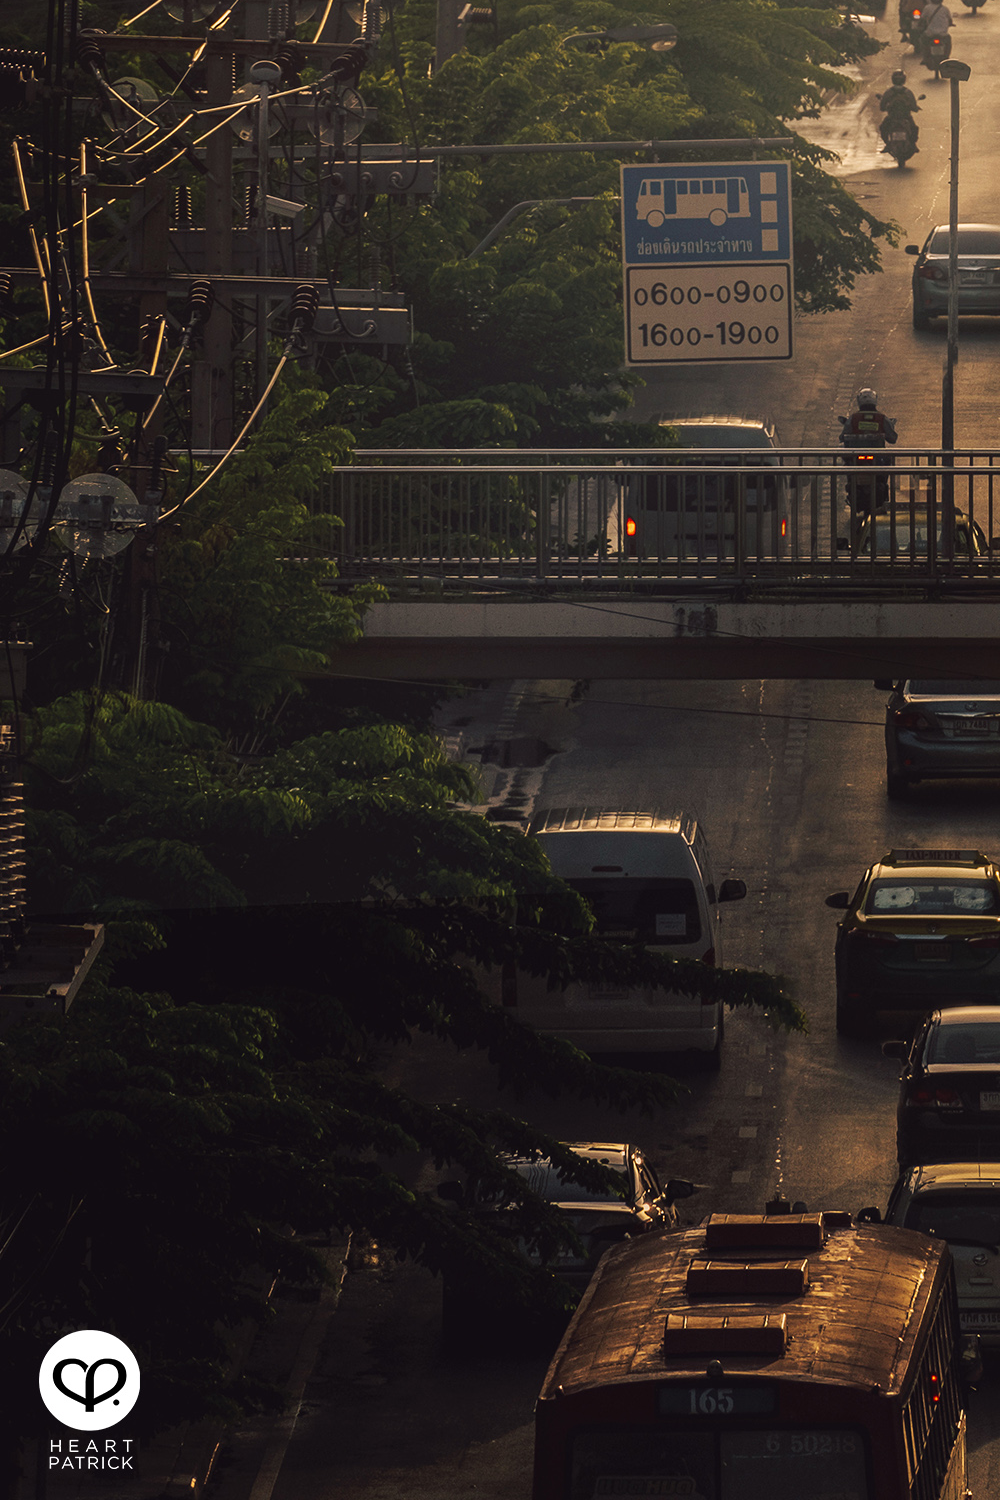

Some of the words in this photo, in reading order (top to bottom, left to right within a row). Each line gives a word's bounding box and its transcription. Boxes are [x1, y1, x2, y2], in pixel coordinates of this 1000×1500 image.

[637, 236, 753, 256] ช่องเดินรถประจำทาง
[634, 280, 784, 306] 0600-0900
[638, 321, 779, 347] 1600-1900
[905, 850, 961, 860] TAXI-METER
[688, 1388, 735, 1414] 165
